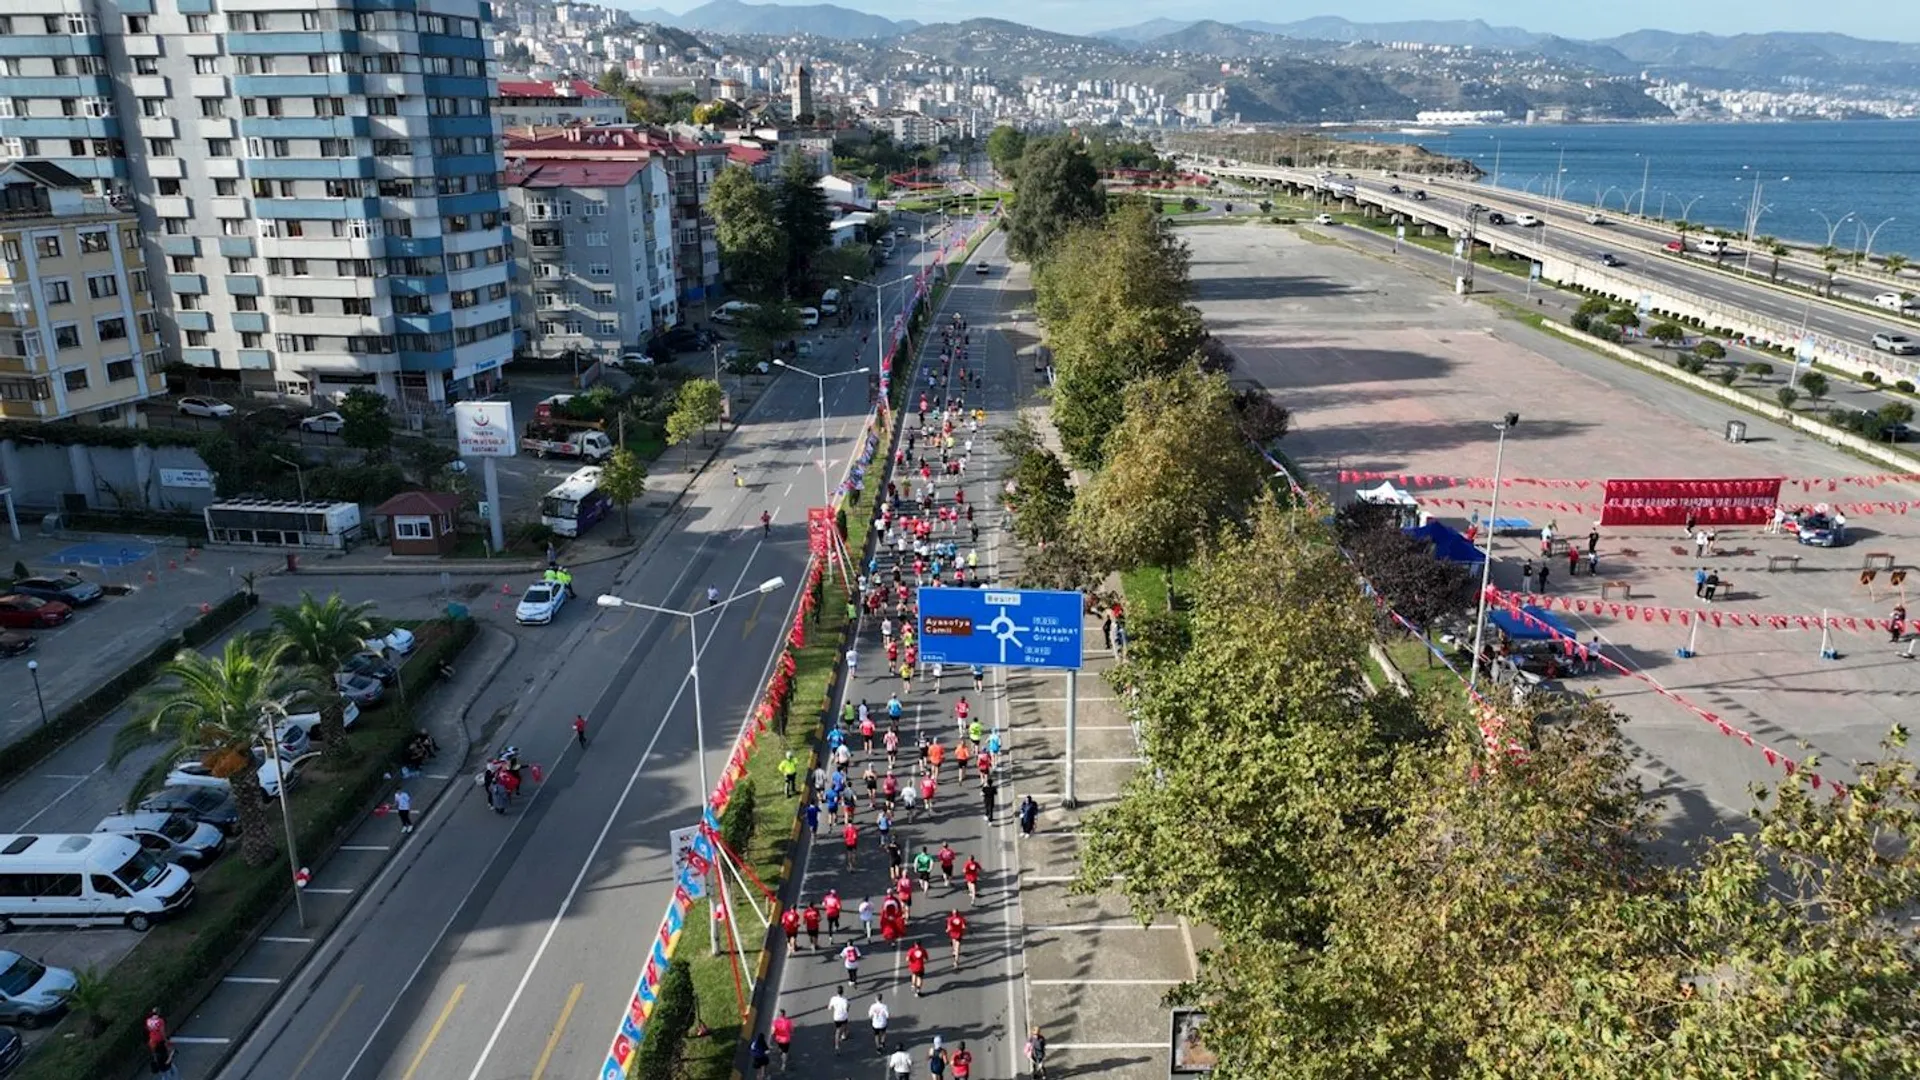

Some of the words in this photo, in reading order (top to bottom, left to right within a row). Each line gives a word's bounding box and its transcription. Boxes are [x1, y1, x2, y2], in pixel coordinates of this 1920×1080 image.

[925, 618, 970, 627] Ayasofya
[1034, 626, 1078, 635] Akçaabat
[1033, 634, 1070, 643] Giresun
[1025, 655, 1045, 663] Rize
